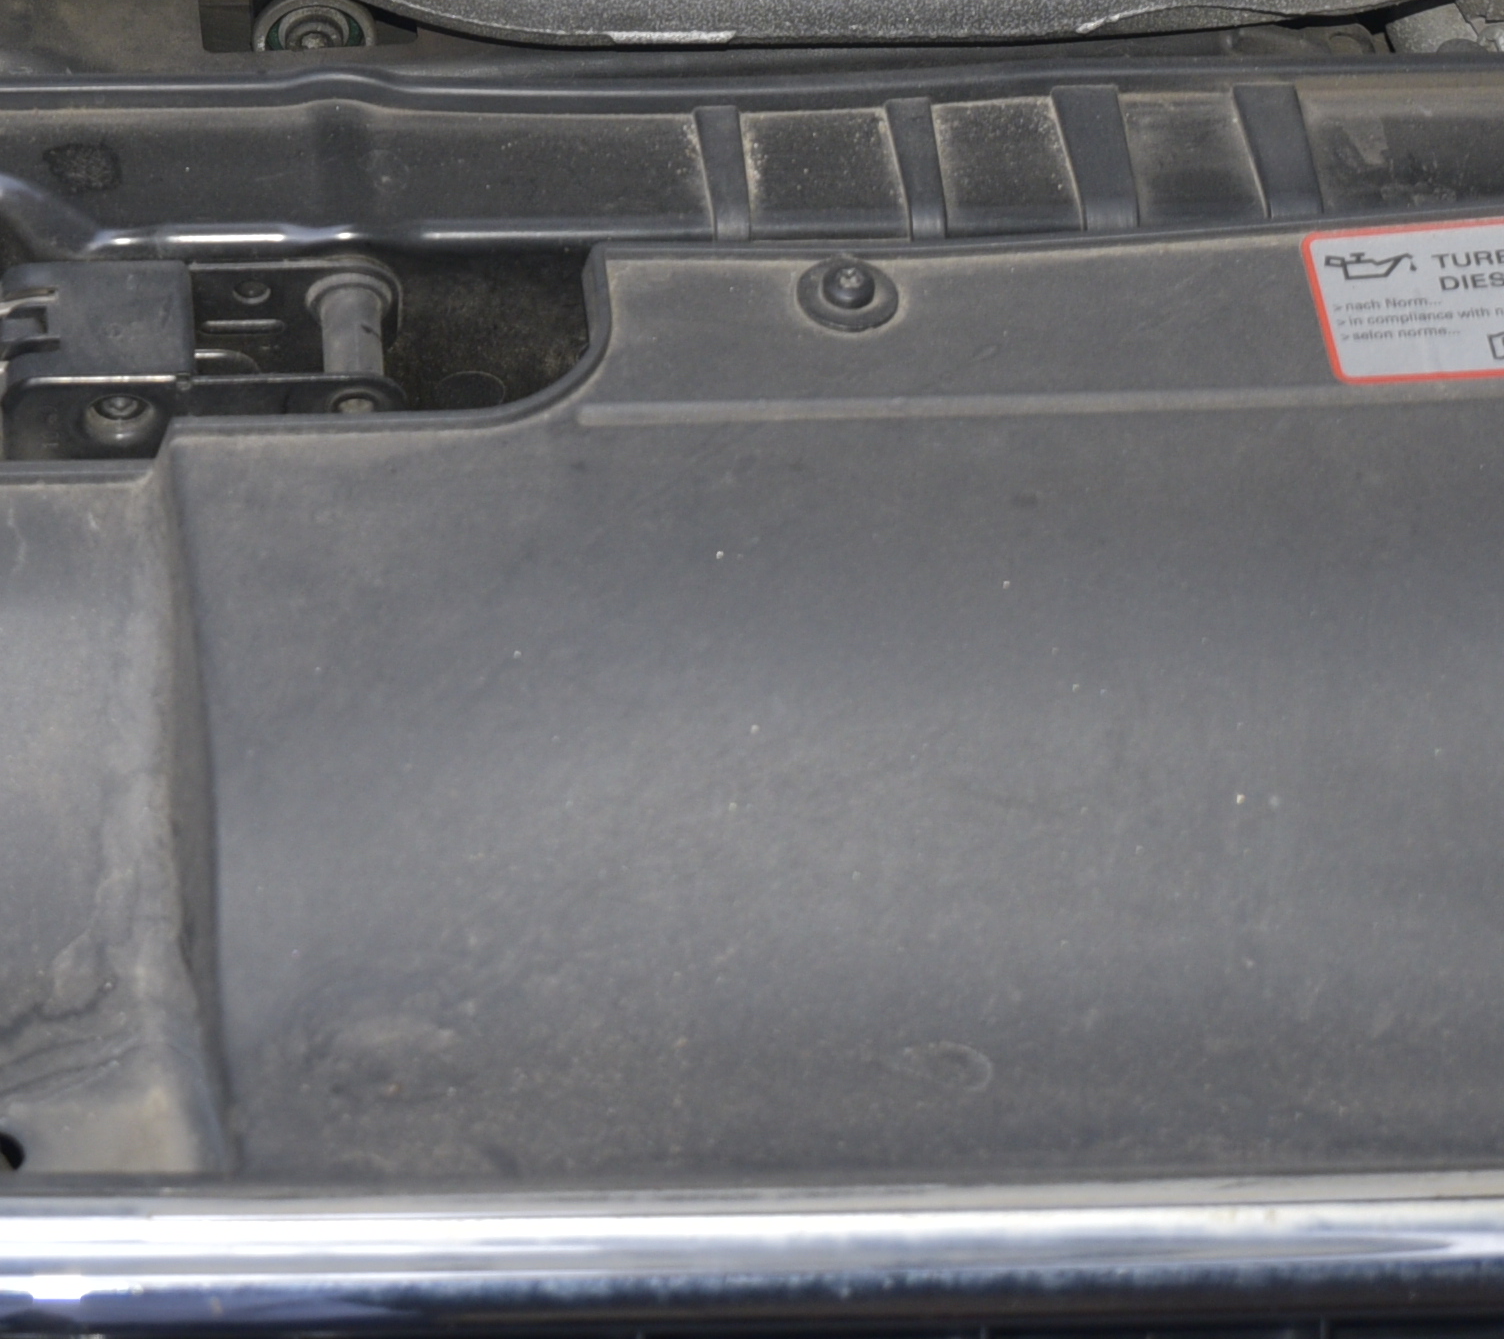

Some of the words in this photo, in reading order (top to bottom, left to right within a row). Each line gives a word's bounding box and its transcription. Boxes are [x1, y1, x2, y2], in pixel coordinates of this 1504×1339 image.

[1345, 298, 1381, 312] nach
[1348, 314, 1363, 327] in
[1367, 309, 1454, 328] compliance
[1457, 306, 1490, 320] with
[1352, 328, 1393, 341] selon
